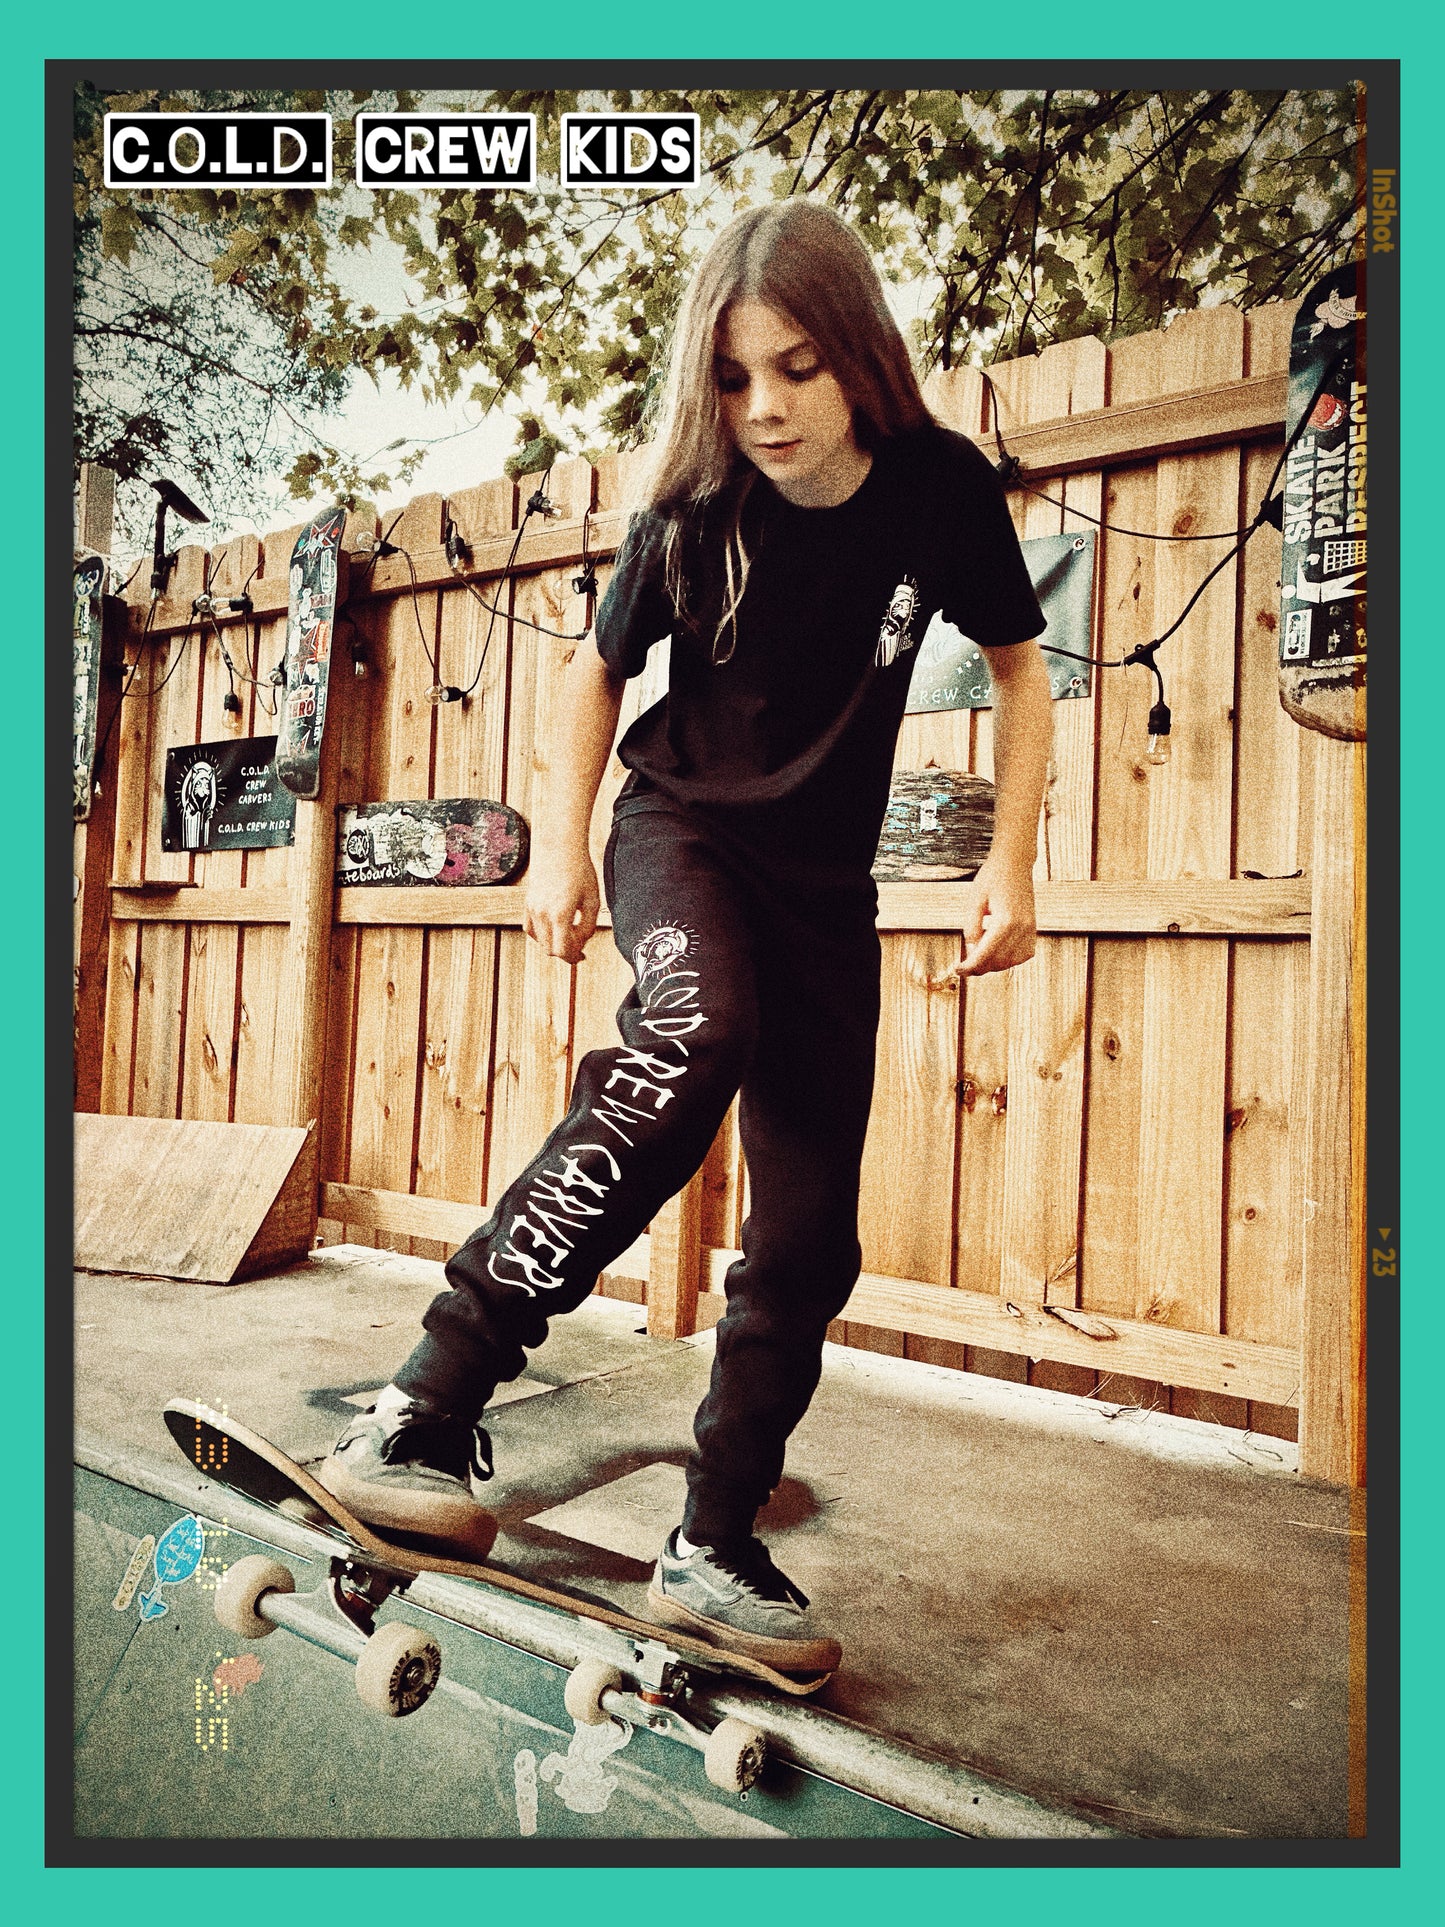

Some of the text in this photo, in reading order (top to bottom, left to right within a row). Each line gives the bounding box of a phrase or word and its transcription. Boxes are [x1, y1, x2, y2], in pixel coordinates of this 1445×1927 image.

[1284, 433, 1316, 545] SKATE
[1314, 440, 1347, 540] PARK
[907, 686, 959, 705] CREW
[245, 780, 267, 790] CREW
[238, 792, 272, 805] CARVERS
[246, 821, 268, 832] CREW
[268, 819, 291, 831] KIDS
[487, 1143, 622, 1298] CARVERS
